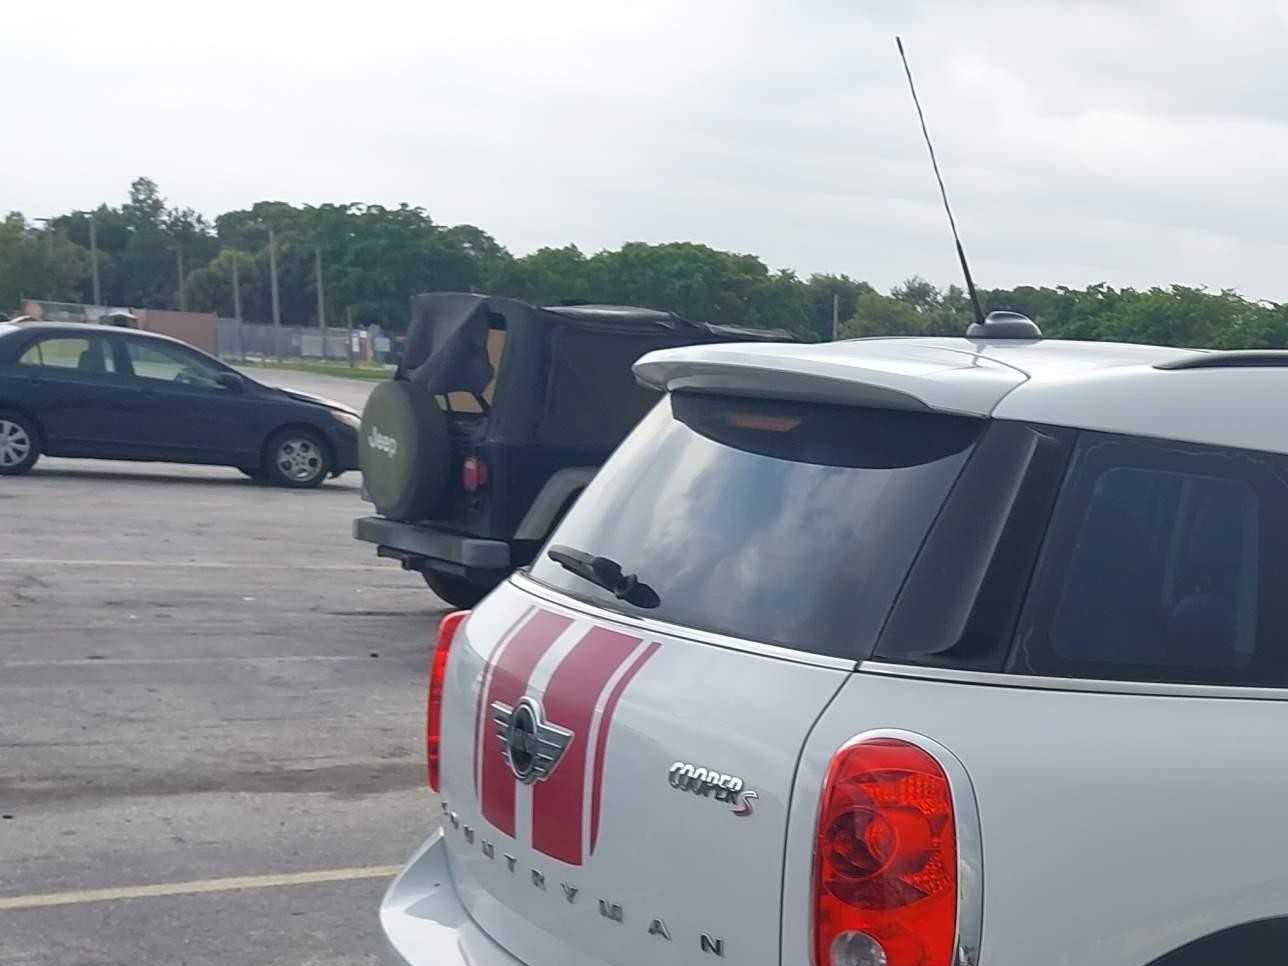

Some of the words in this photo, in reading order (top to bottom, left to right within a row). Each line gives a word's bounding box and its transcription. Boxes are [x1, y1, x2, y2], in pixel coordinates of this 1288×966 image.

[367, 425, 398, 458] Jeep
[669, 762, 743, 805] COOPER
[731, 790, 759, 816] S
